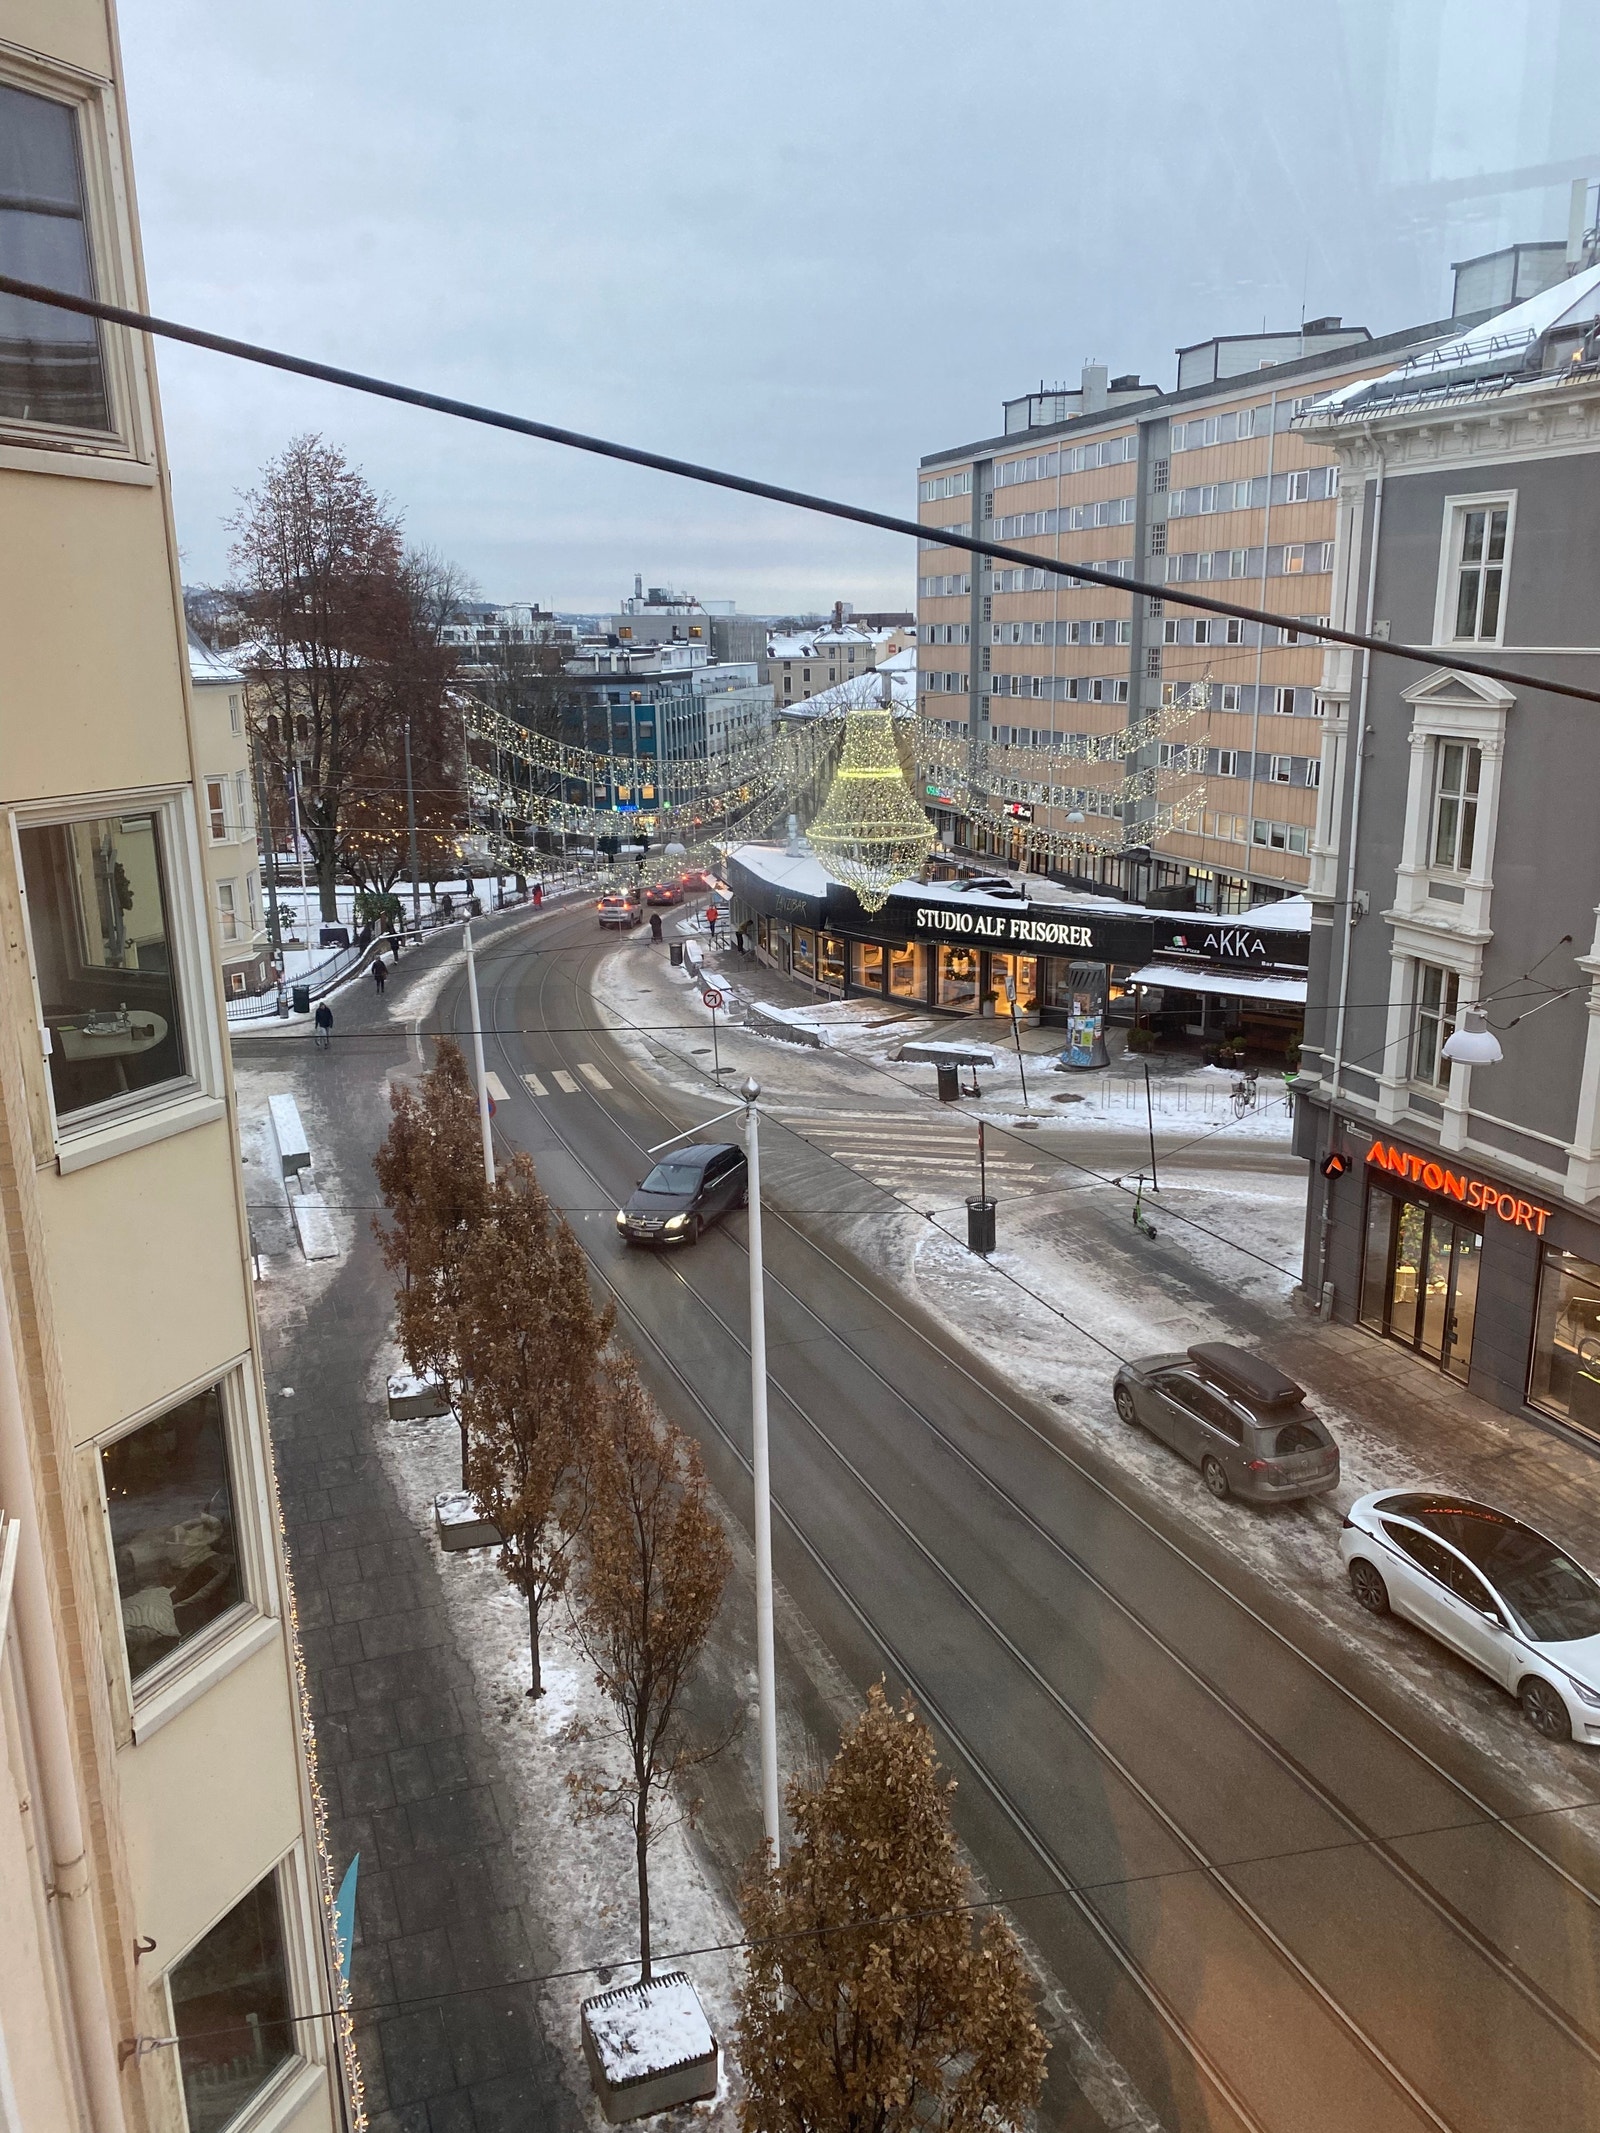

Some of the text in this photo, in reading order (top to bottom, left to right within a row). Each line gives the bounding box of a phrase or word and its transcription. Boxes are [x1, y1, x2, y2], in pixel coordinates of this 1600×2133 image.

[916, 908, 1093, 947] STUDIO ALF FRISØRER
[1203, 929, 1266, 958] AKKA
